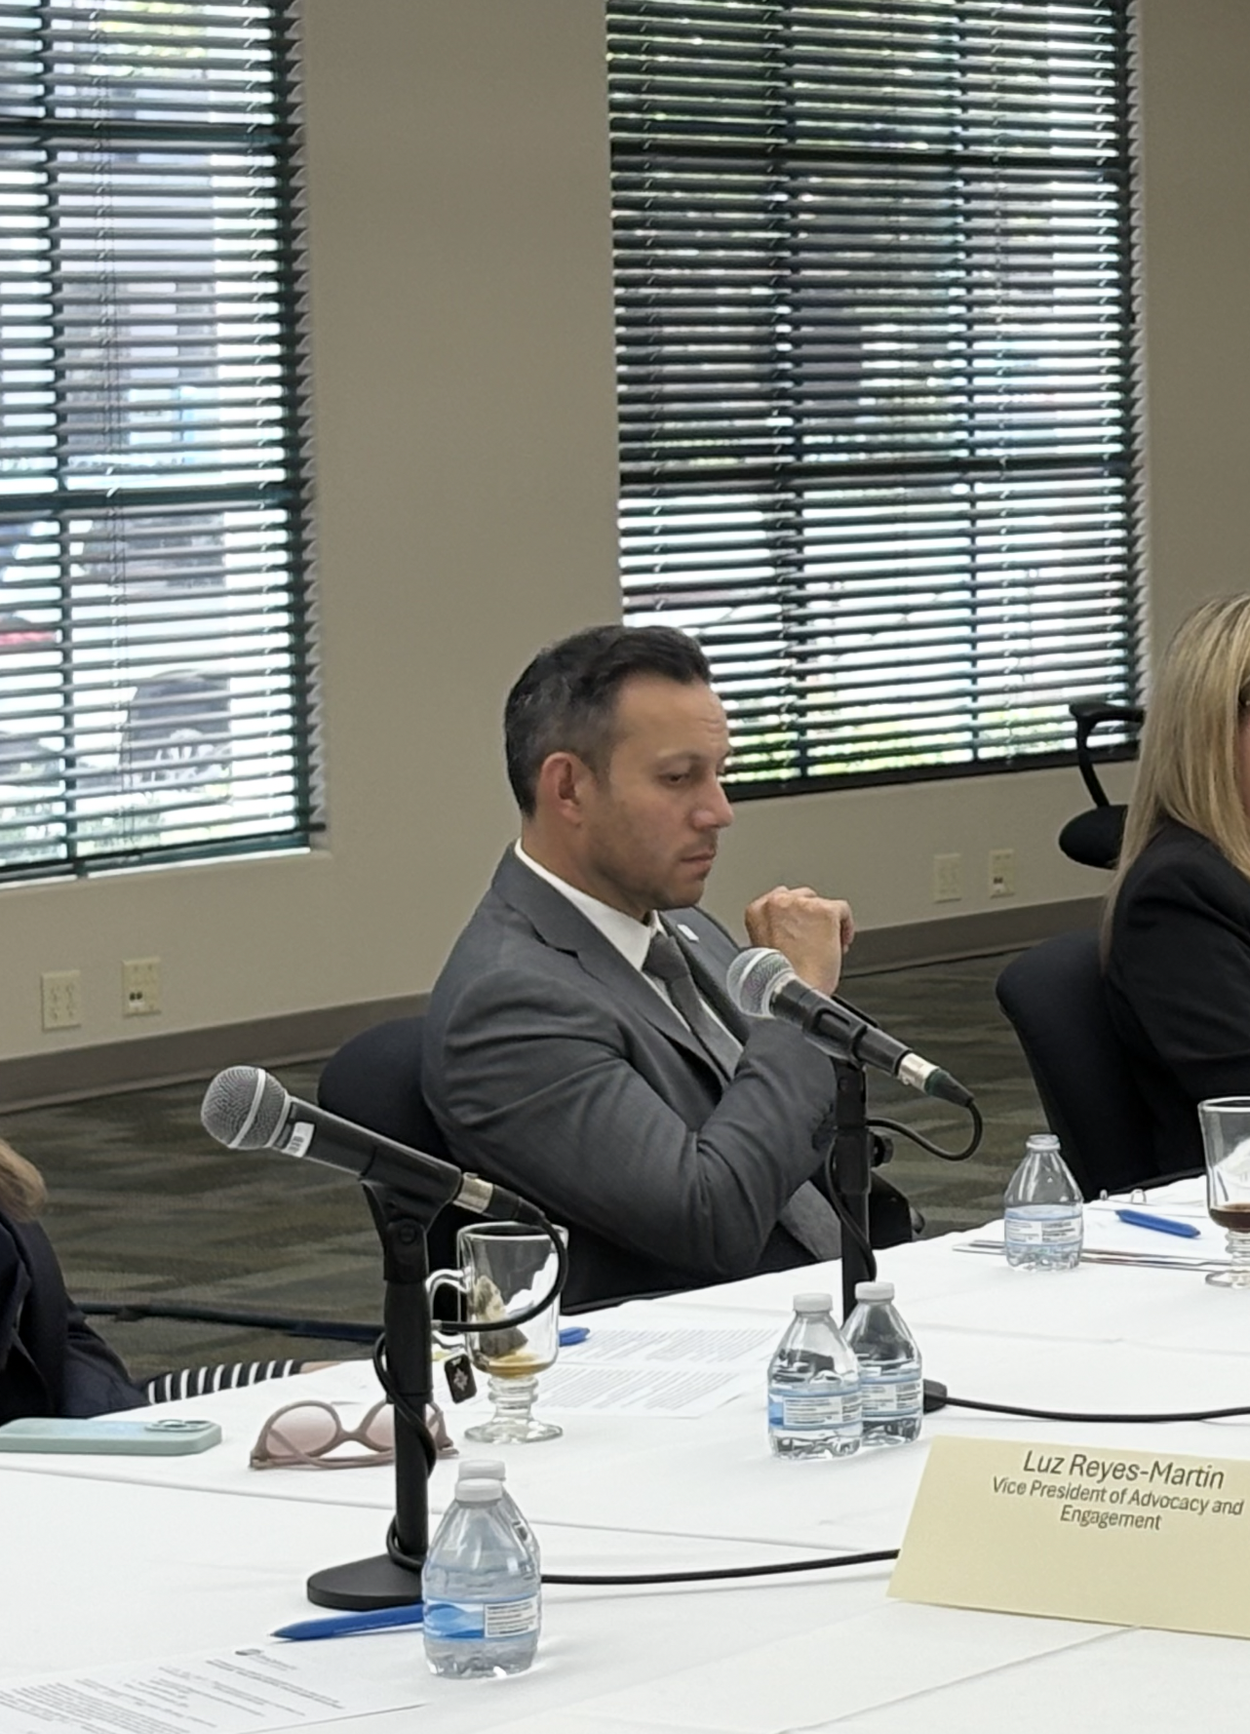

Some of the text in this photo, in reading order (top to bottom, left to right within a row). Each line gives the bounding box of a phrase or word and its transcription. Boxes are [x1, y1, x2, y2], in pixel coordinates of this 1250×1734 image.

[1023, 1450, 1225, 1489] Luz Reyes-Martin
[993, 1476, 1245, 1516] Vice President of Advocacy and
[1060, 1504, 1162, 1531] Engagement
